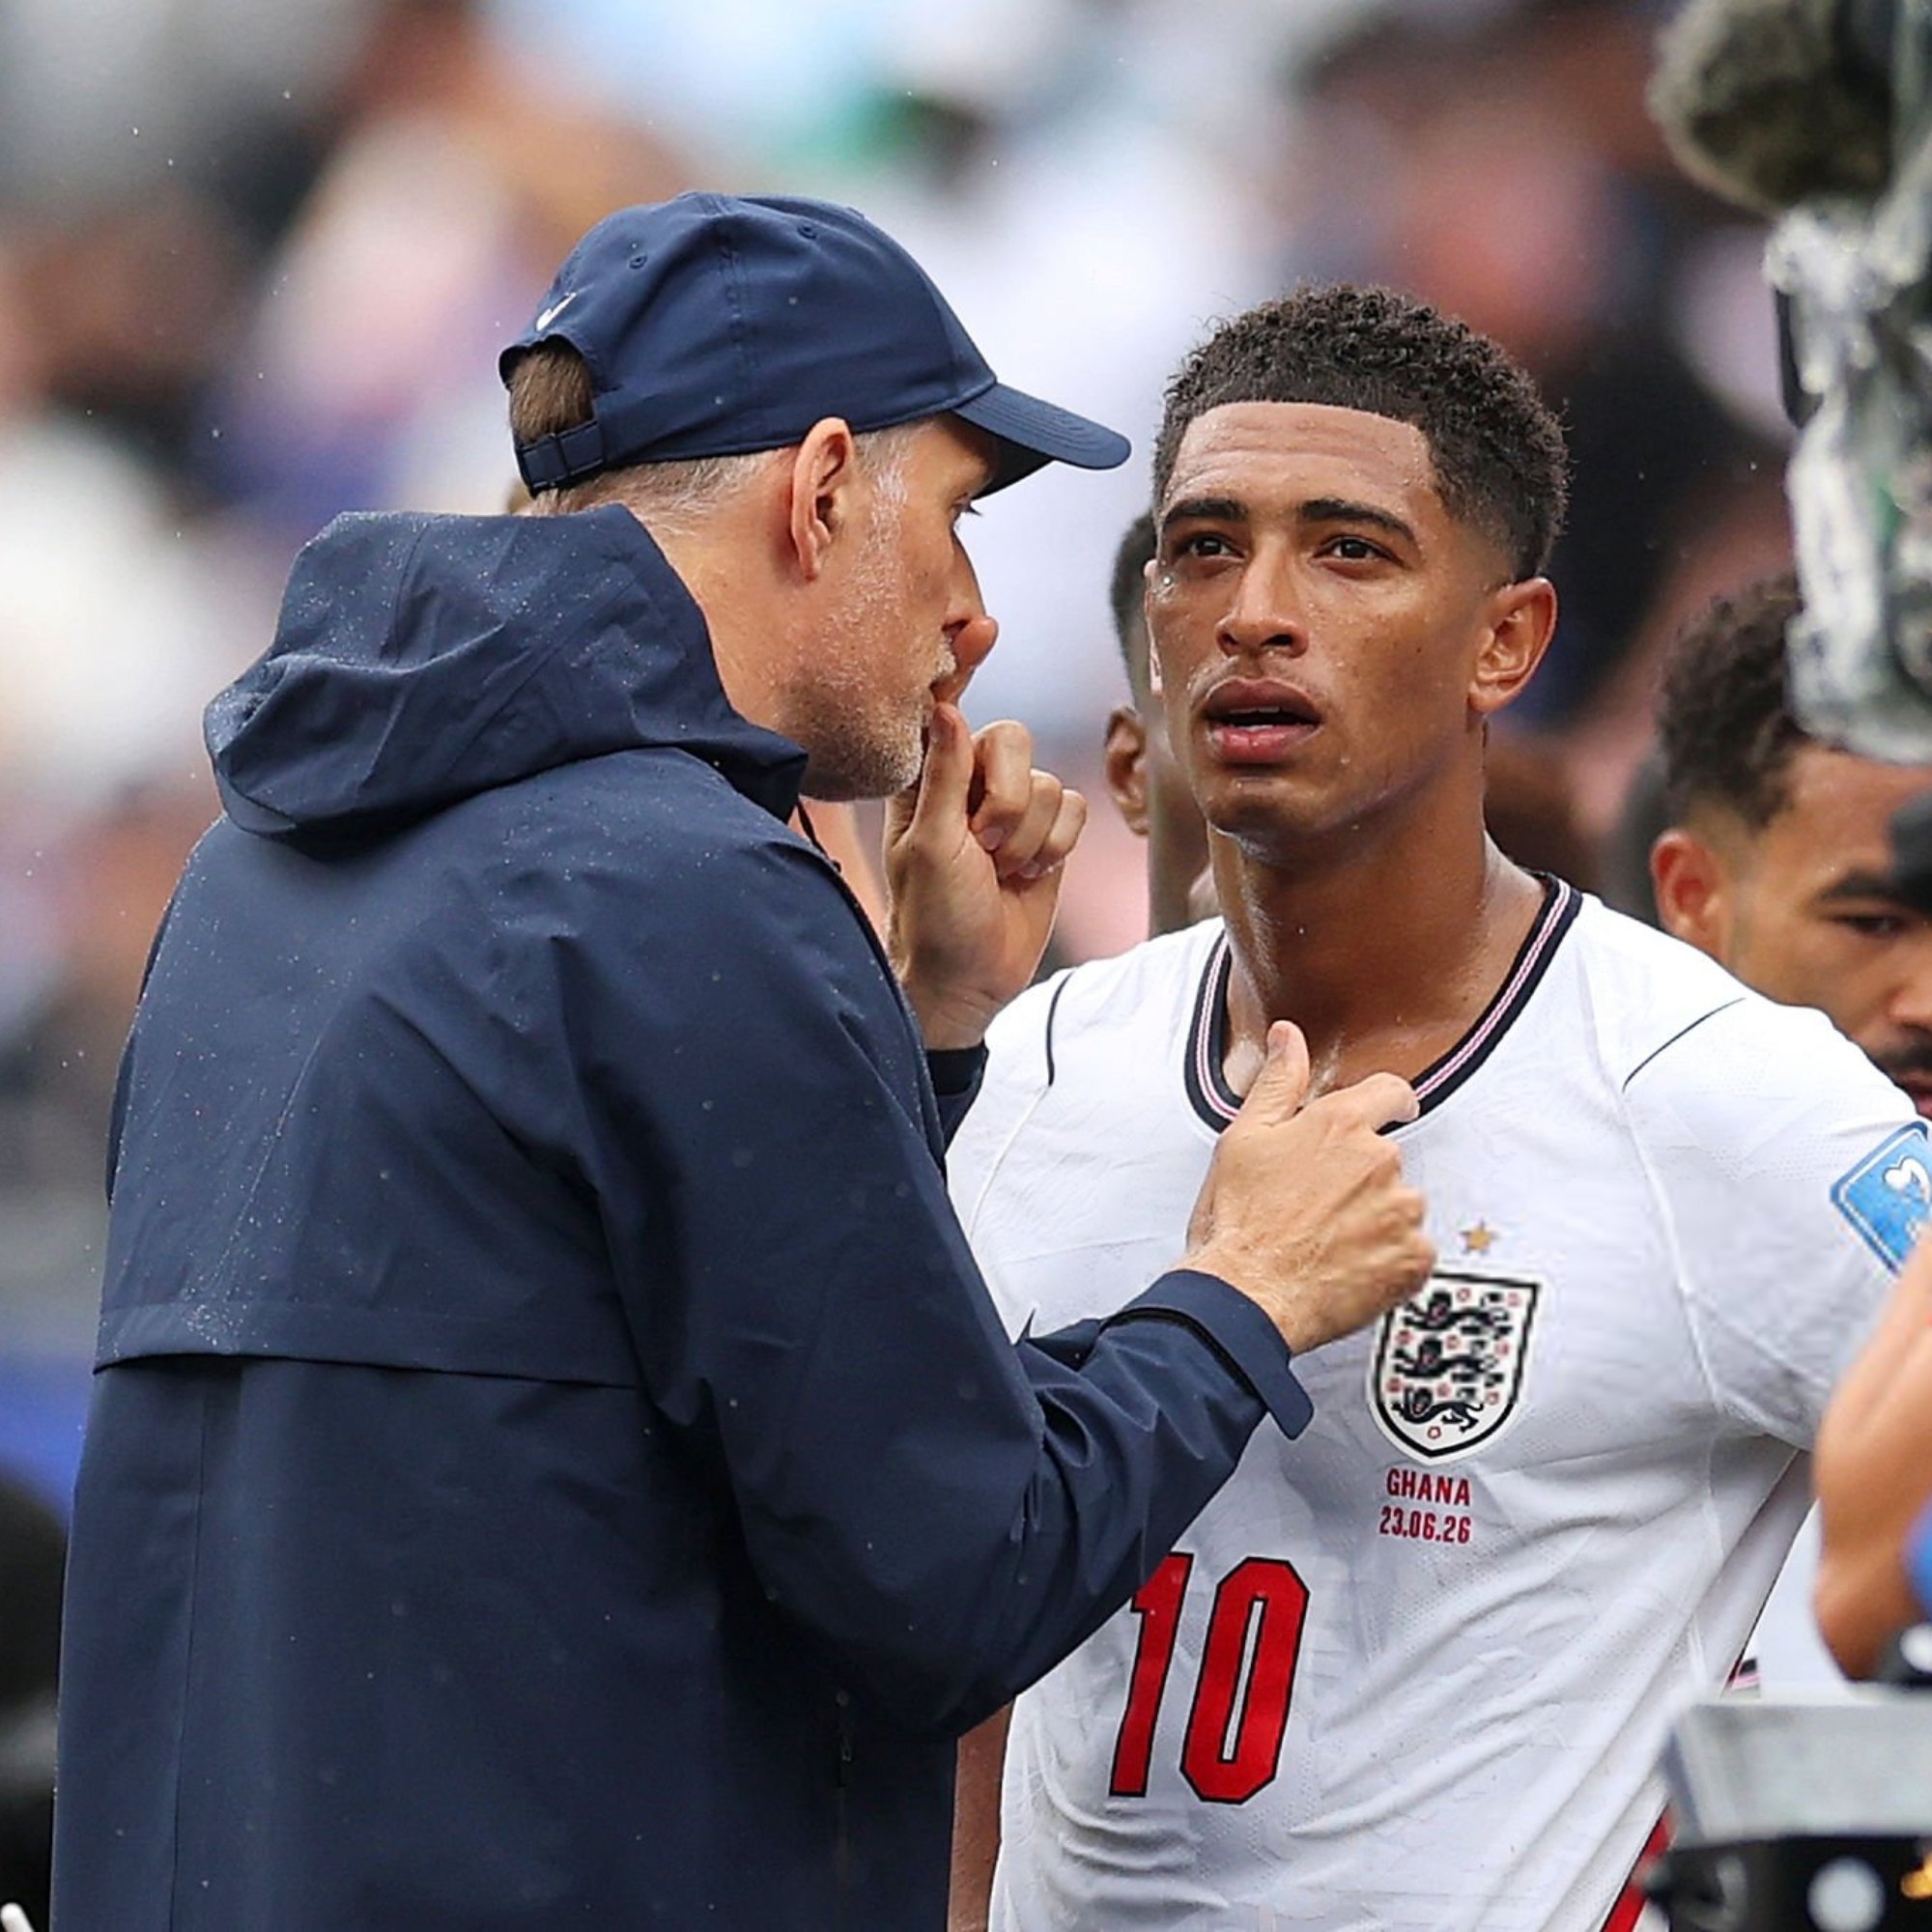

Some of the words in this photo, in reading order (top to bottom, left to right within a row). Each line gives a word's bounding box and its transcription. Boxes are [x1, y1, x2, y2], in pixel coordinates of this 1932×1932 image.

[1386, 1467, 1471, 1506] GHANA
[1379, 1505, 1471, 1544] 23.06.26
[1109, 1552, 1310, 1805] 10
